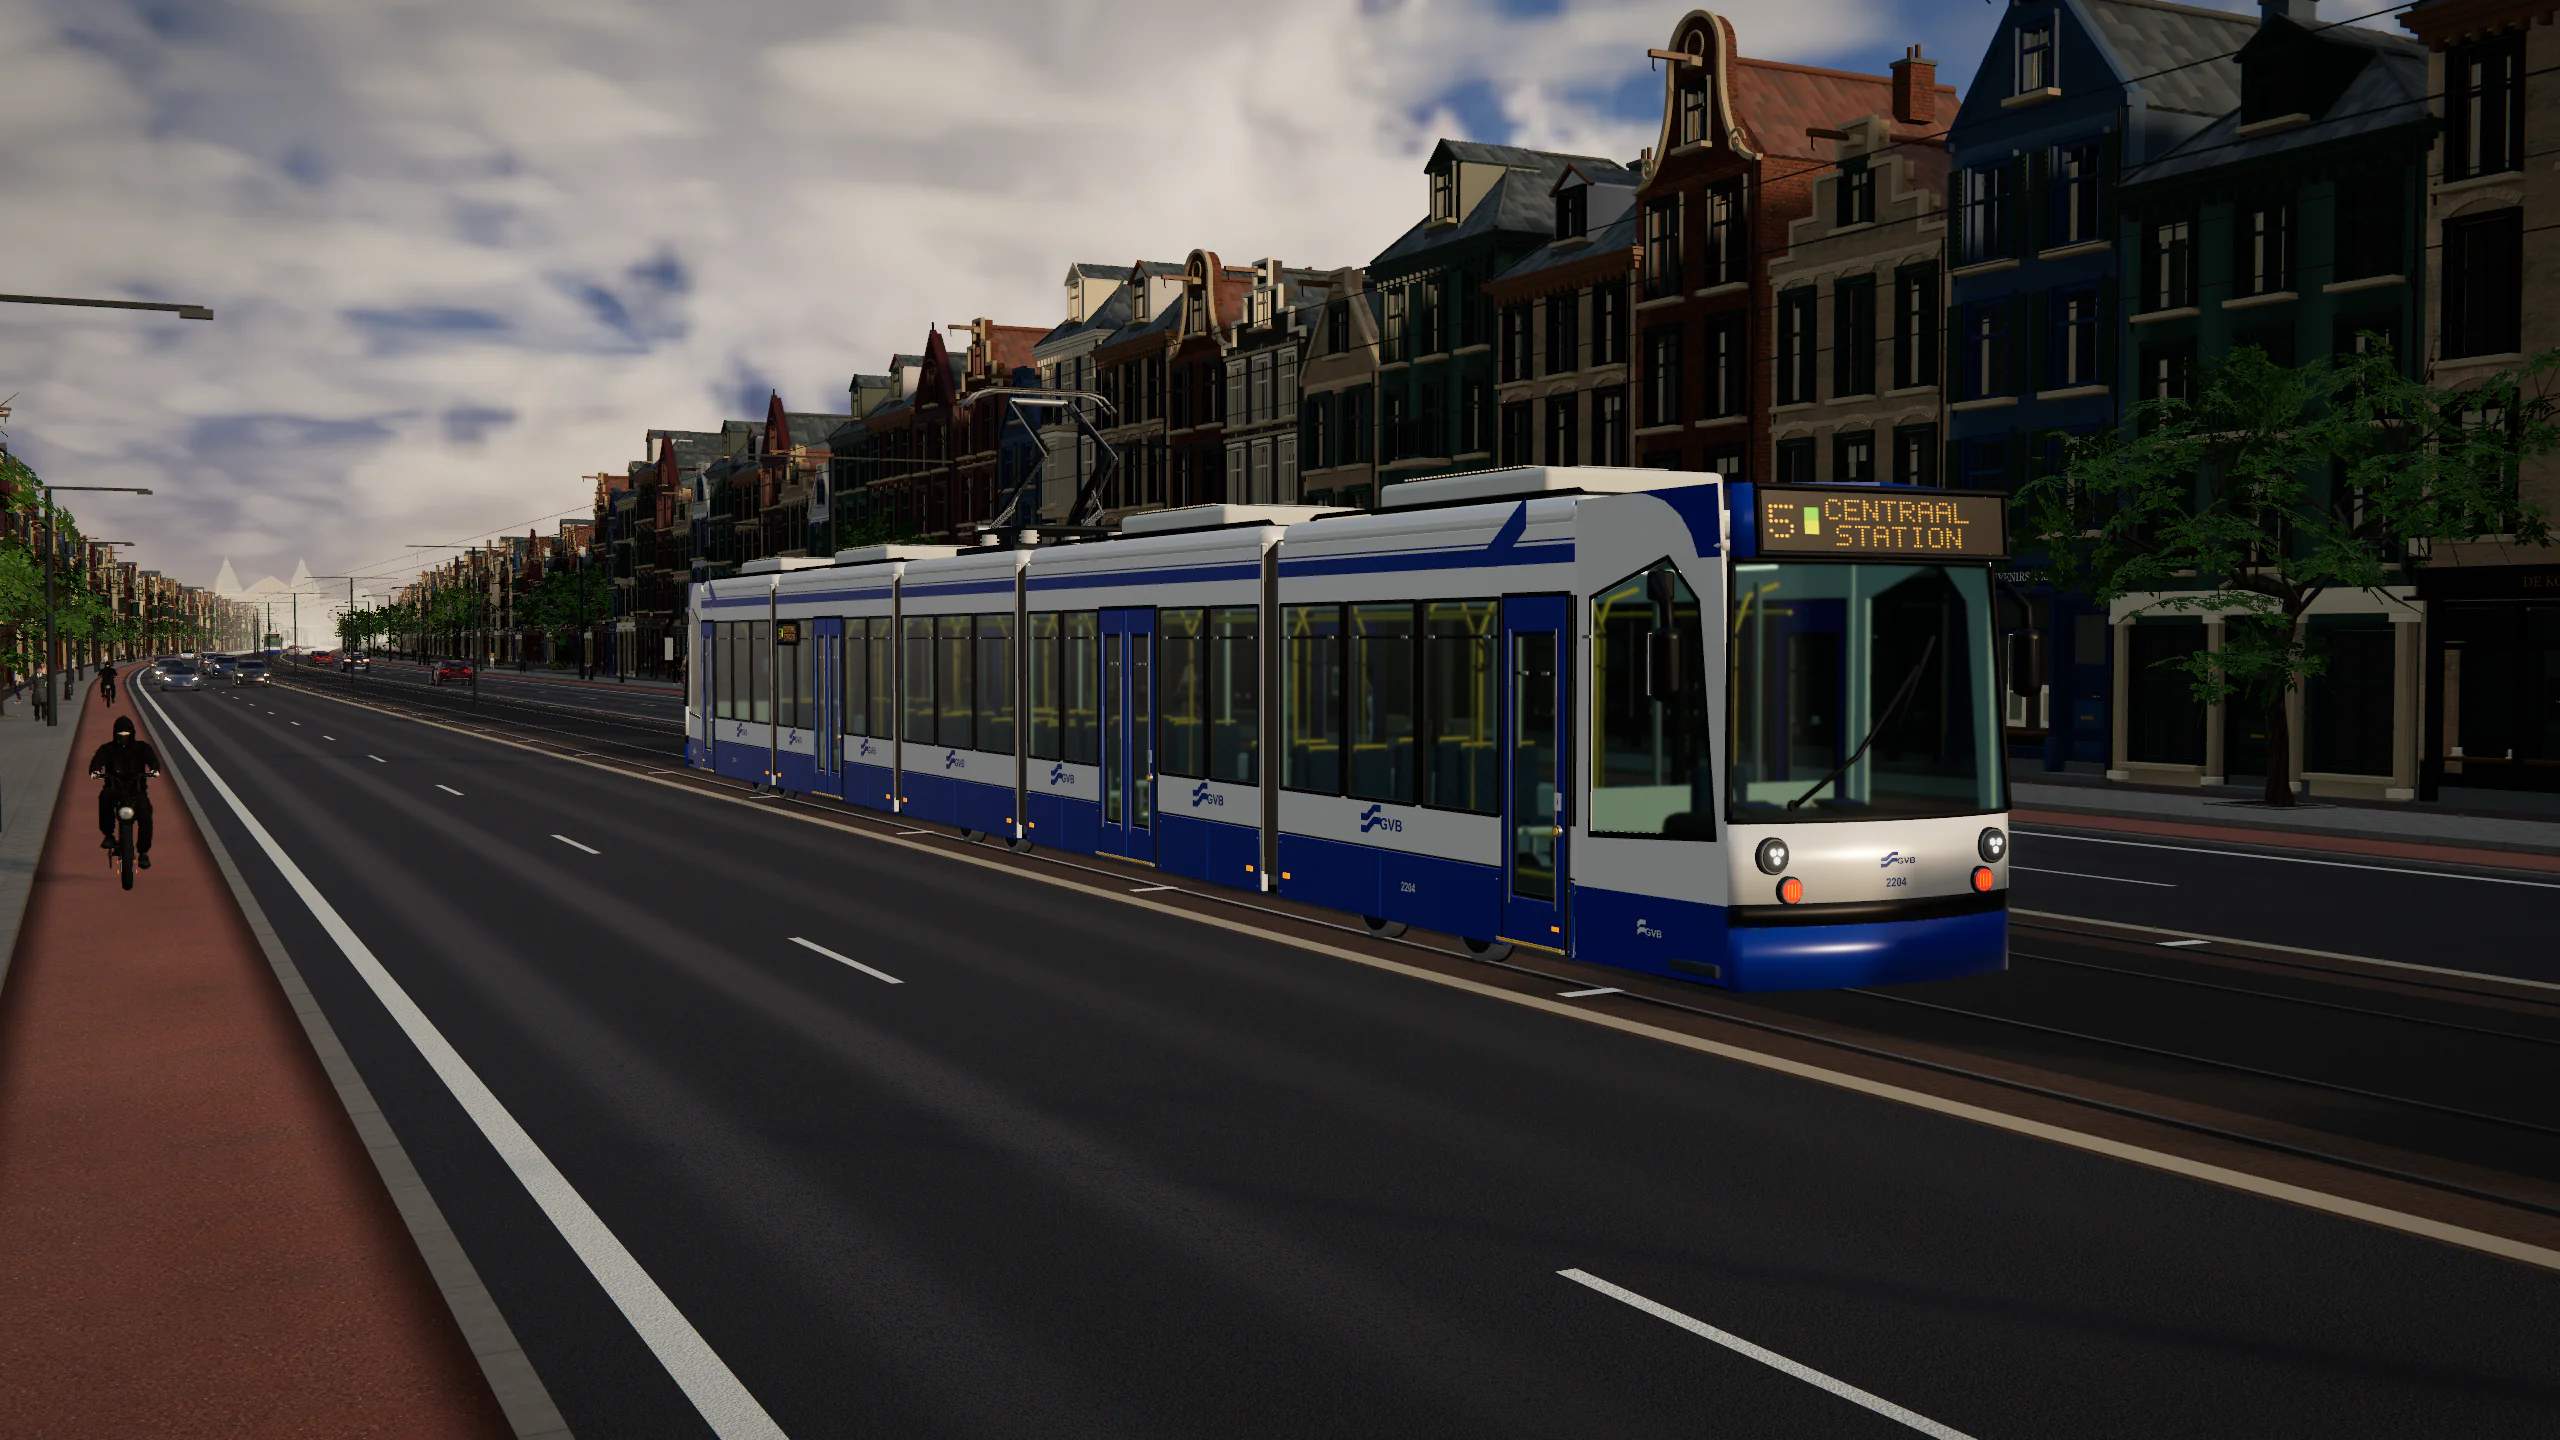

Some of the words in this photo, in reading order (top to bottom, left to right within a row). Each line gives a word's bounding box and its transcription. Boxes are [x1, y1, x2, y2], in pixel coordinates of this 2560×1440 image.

[1825, 498, 1970, 525] CENTRAAL
[1767, 503, 1795, 539] 5
[1836, 525, 1963, 550] STATION
[2522, 576, 2543, 588] DE
[1062, 773, 1075, 784] GVB
[1207, 793, 1224, 806] GVB
[1380, 818, 1403, 833] GVB
[1400, 881, 1416, 893] 2204
[1886, 877, 1907, 887] 2204
[1646, 928, 1663, 938] GVB
